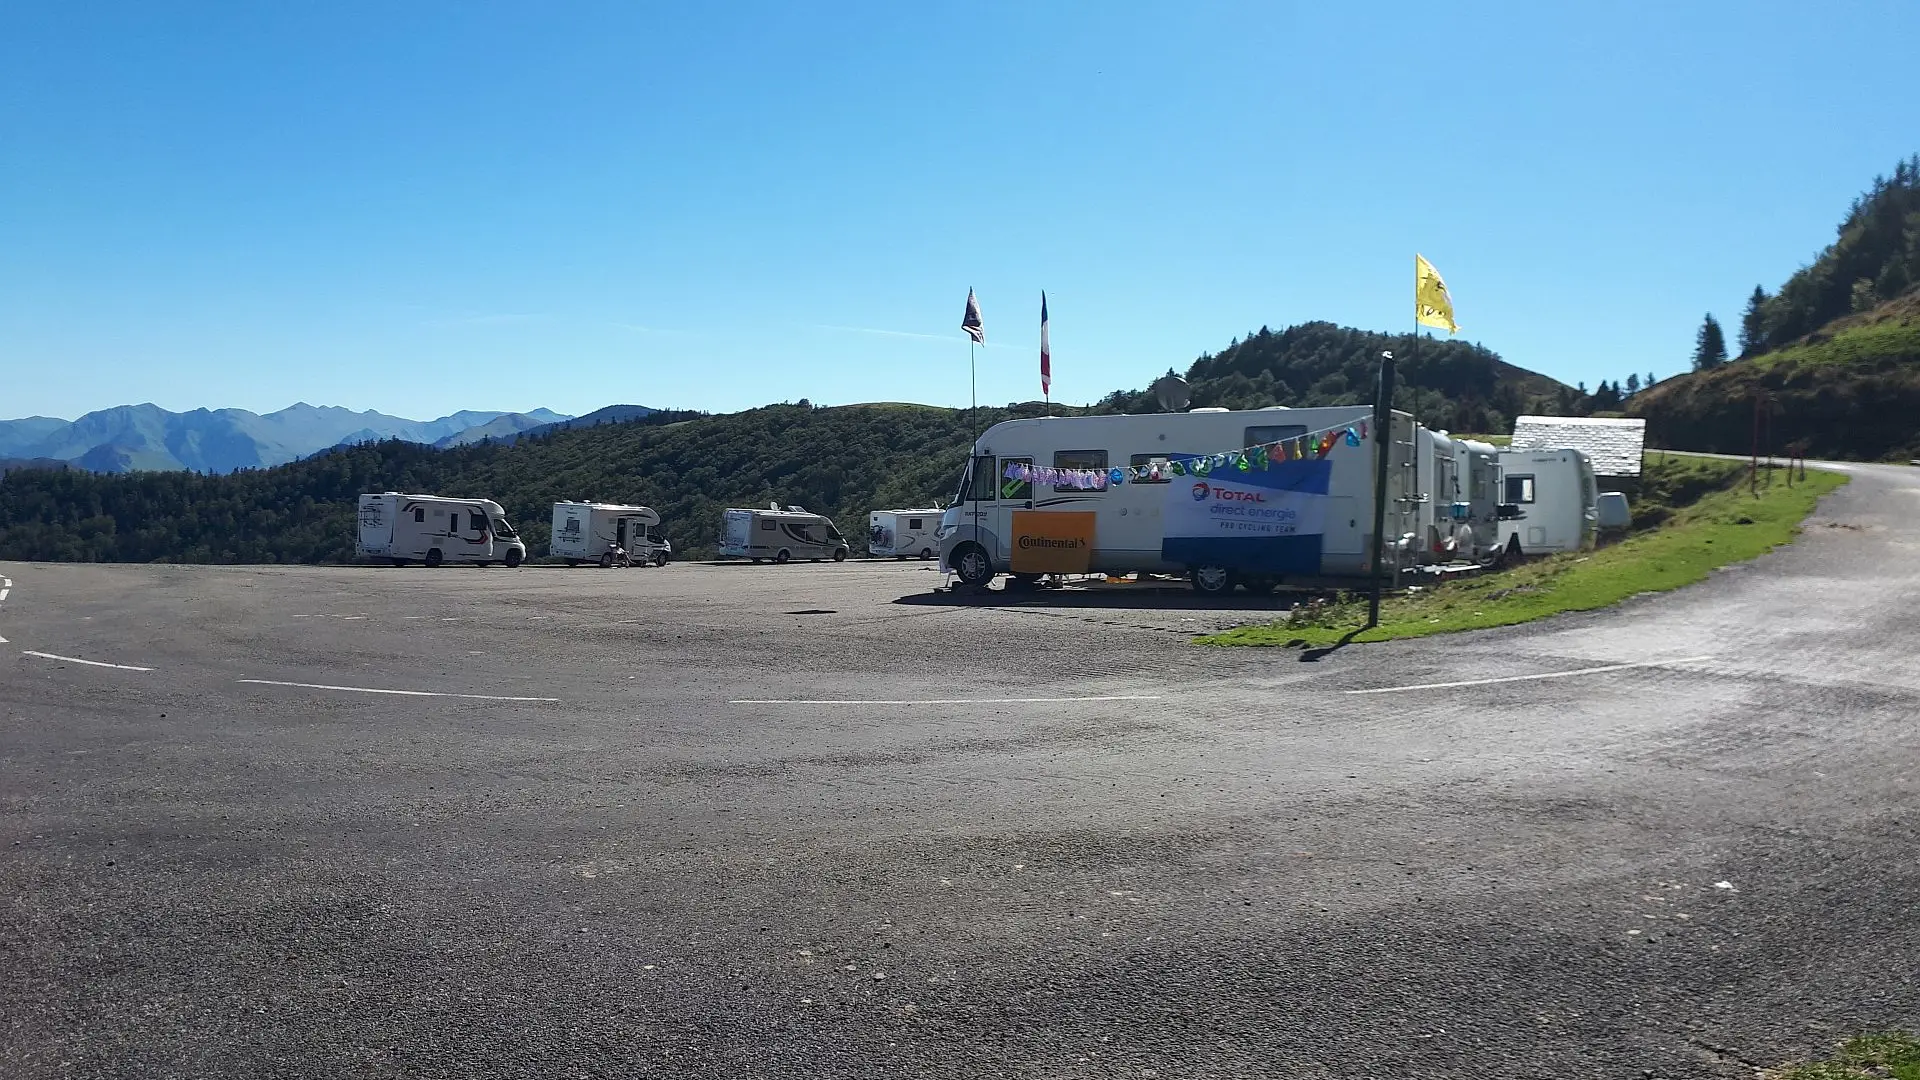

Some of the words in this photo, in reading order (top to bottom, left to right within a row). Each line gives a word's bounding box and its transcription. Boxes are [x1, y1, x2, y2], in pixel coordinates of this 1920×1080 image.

[1213, 488, 1266, 503] TOTAL
[1210, 503, 1245, 516] direct
[1248, 507, 1297, 521] energie
[1018, 535, 1078, 549] Continental
